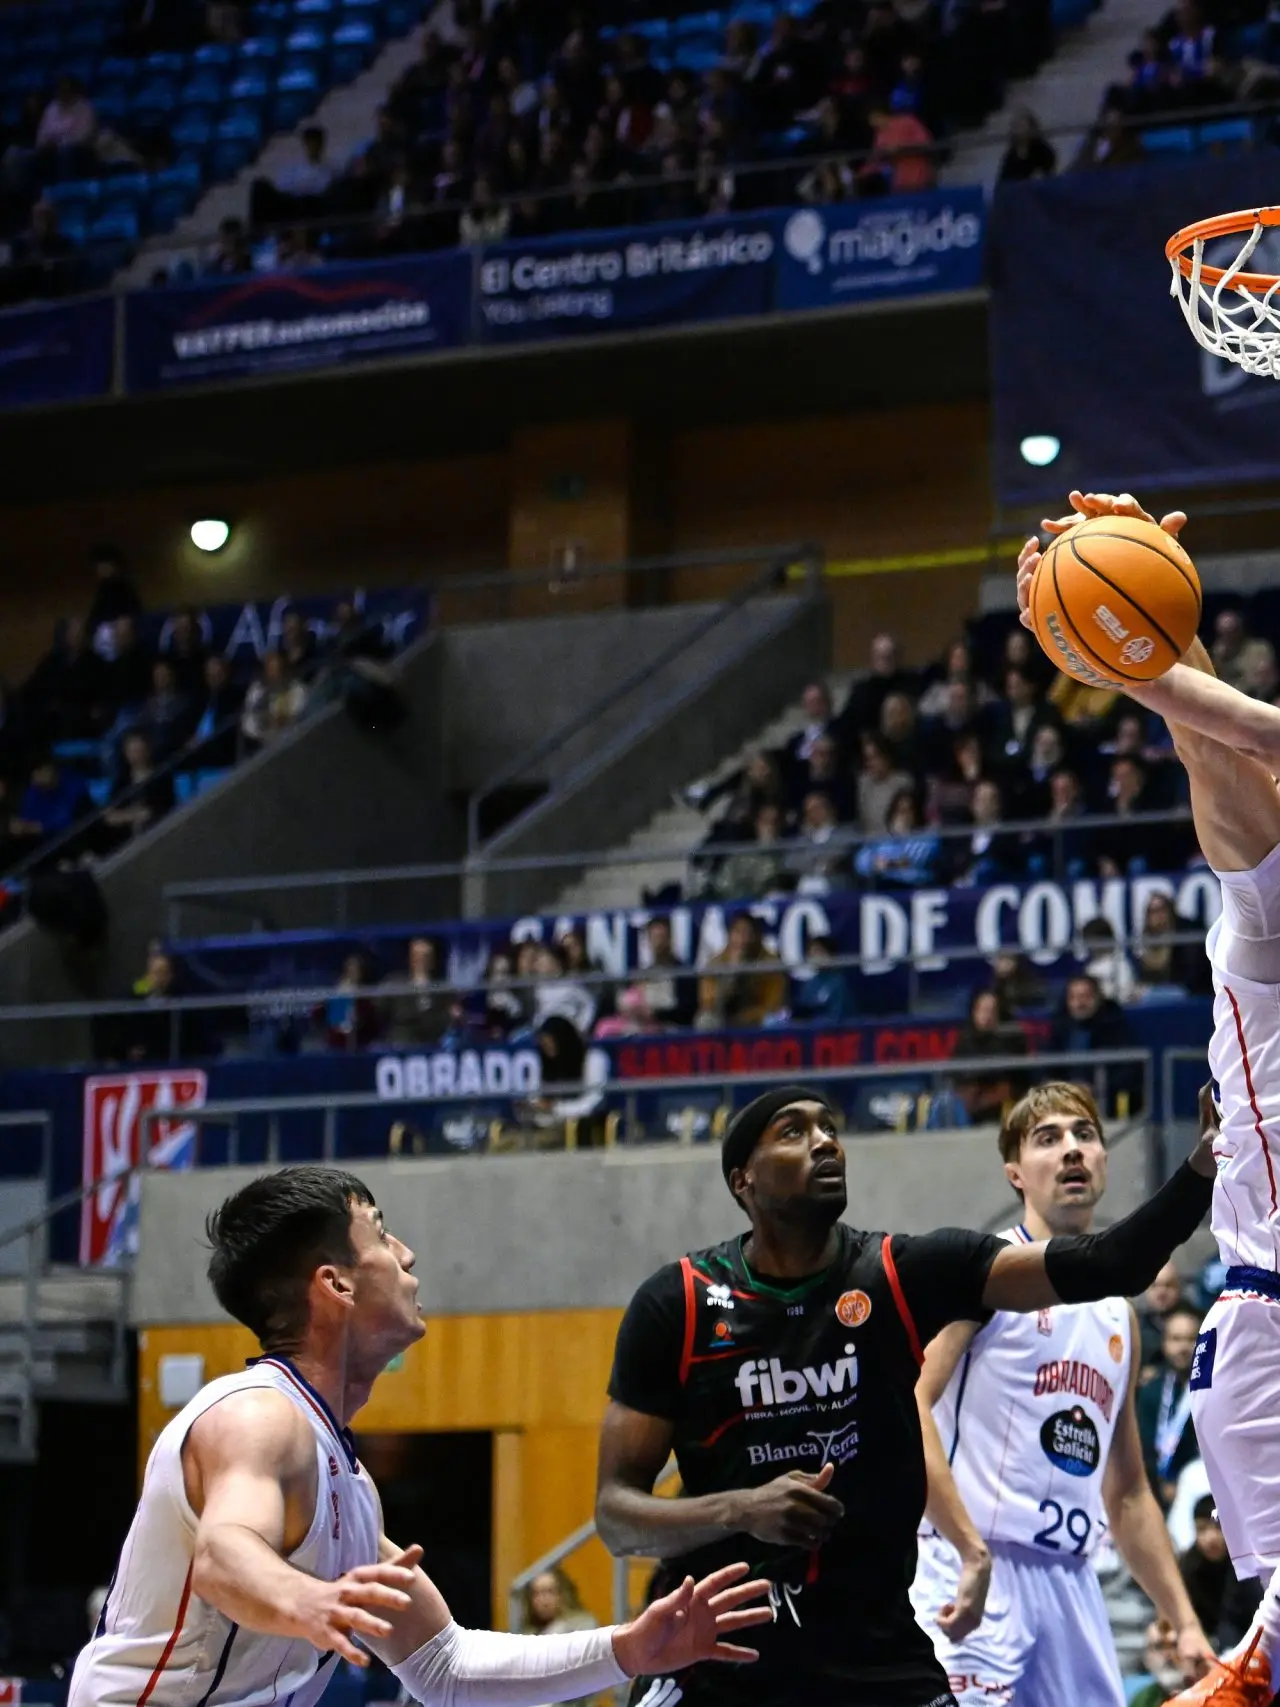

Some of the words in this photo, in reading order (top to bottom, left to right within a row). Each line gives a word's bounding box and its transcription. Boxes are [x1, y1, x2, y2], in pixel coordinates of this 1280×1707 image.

[480, 258, 511, 294] El
[512, 250, 624, 291] Centro
[625, 228, 775, 278] Británico
[860, 889, 949, 976] DE
[734, 1342, 860, 1408] fibwi
[1033, 1499, 1092, 1556] 29
